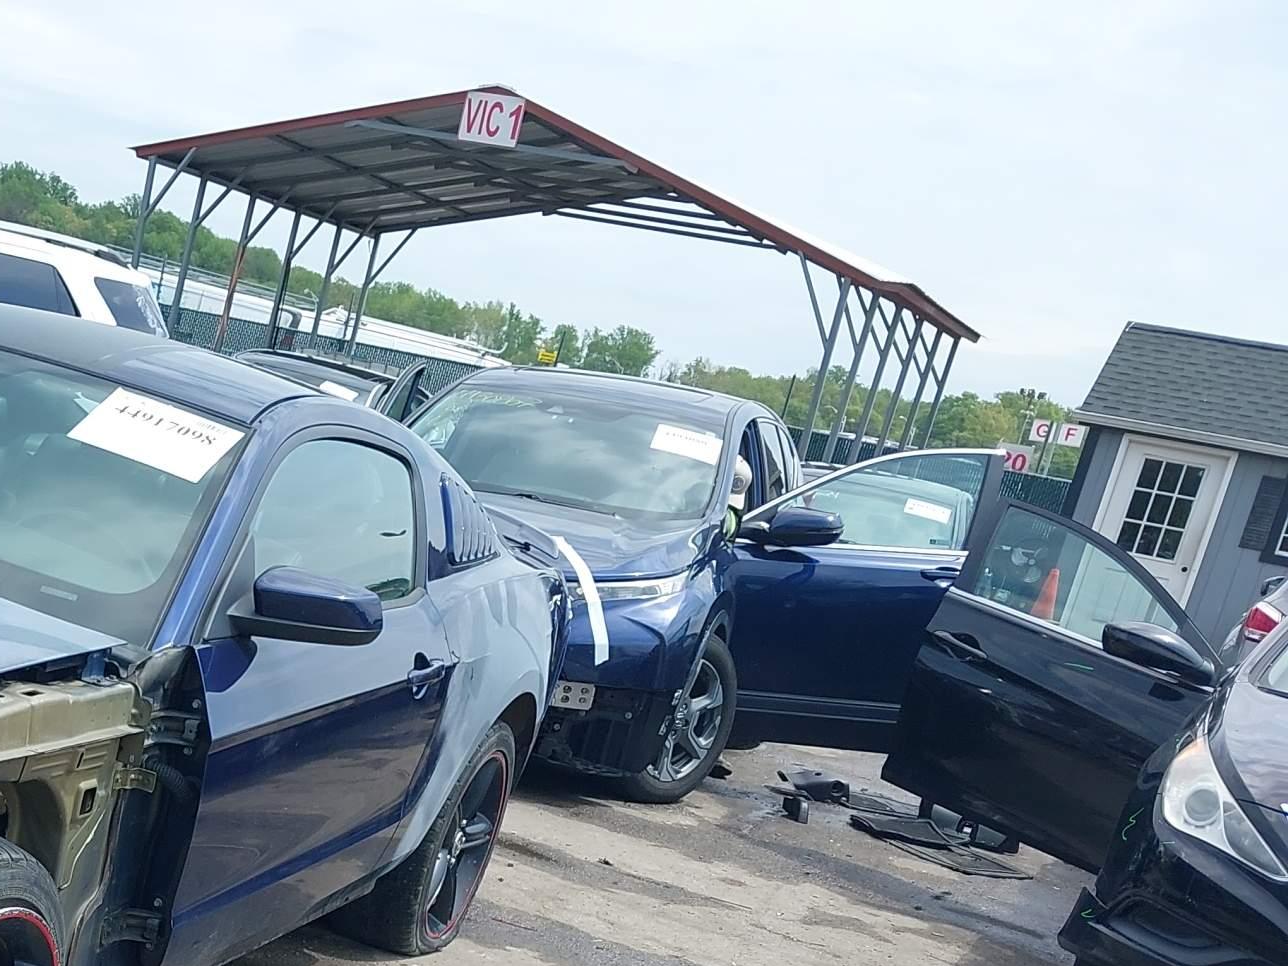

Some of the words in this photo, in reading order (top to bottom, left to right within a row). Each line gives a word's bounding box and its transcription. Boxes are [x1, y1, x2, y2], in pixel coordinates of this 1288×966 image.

[466, 98, 504, 137] VIC
[509, 104, 523, 140] 1
[114, 405, 218, 445] 44917098
[1064, 427, 1079, 442] F
